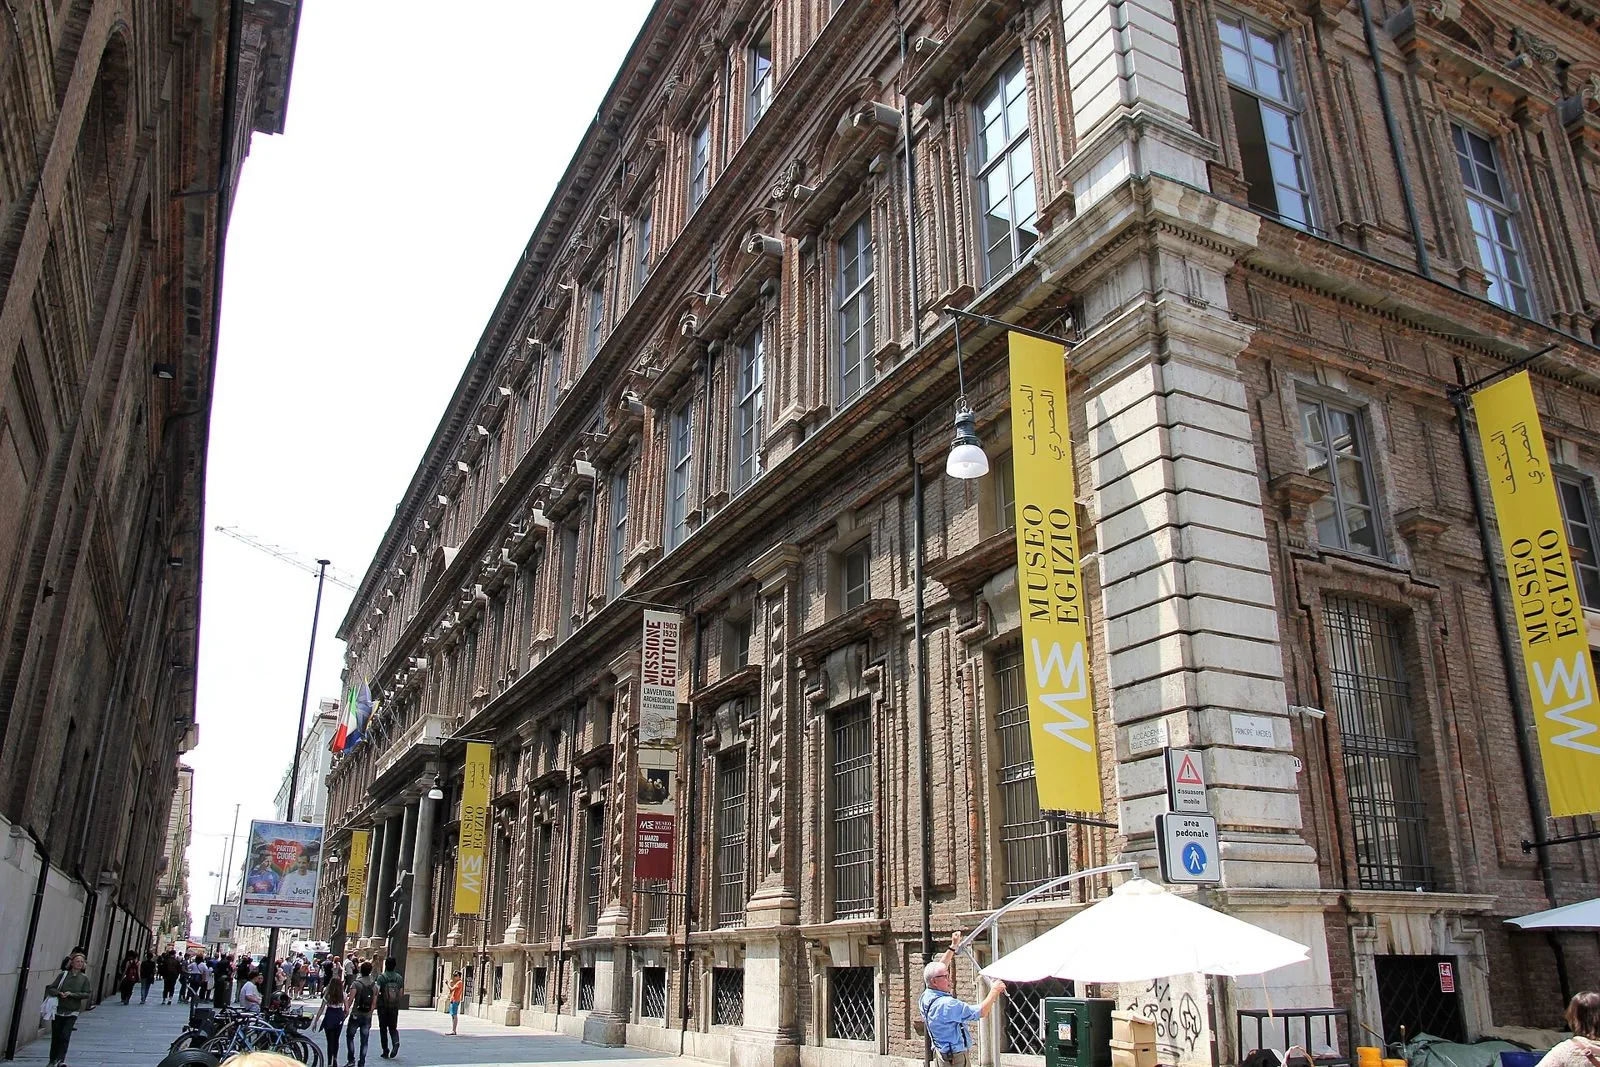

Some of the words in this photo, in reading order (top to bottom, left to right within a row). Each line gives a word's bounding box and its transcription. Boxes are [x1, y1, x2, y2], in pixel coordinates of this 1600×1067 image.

[1020, 384, 1036, 456] المتحف
[1040, 389, 1066, 461] المصري
[1490, 430, 1516, 495] المتحف
[1512, 421, 1546, 485] المصري
[1022, 504, 1051, 624] MUSEO
[1048, 508, 1080, 626] EGIZIO
[1537, 529, 1579, 640] EGIZIO
[1510, 538, 1551, 648] MUSEO
[644, 620, 661, 685] MISSIONE
[661, 638, 677, 687] EGITTO
[643, 688, 675, 697] L'AVVENTURA
[643, 696, 675, 704] ARCHEOLOGICA
[1132, 728, 1164, 741] ACCADEMIA
[1144, 735, 1166, 747] SCIENZE
[1235, 728, 1253, 736] PRINCIPE
[1256, 730, 1272, 738] AMEDEO
[462, 805, 474, 849] MUSEO
[473, 806, 485, 849] EGIZIO
[1175, 829, 1209, 837] pedonale
[277, 852, 296, 860] CUORE
